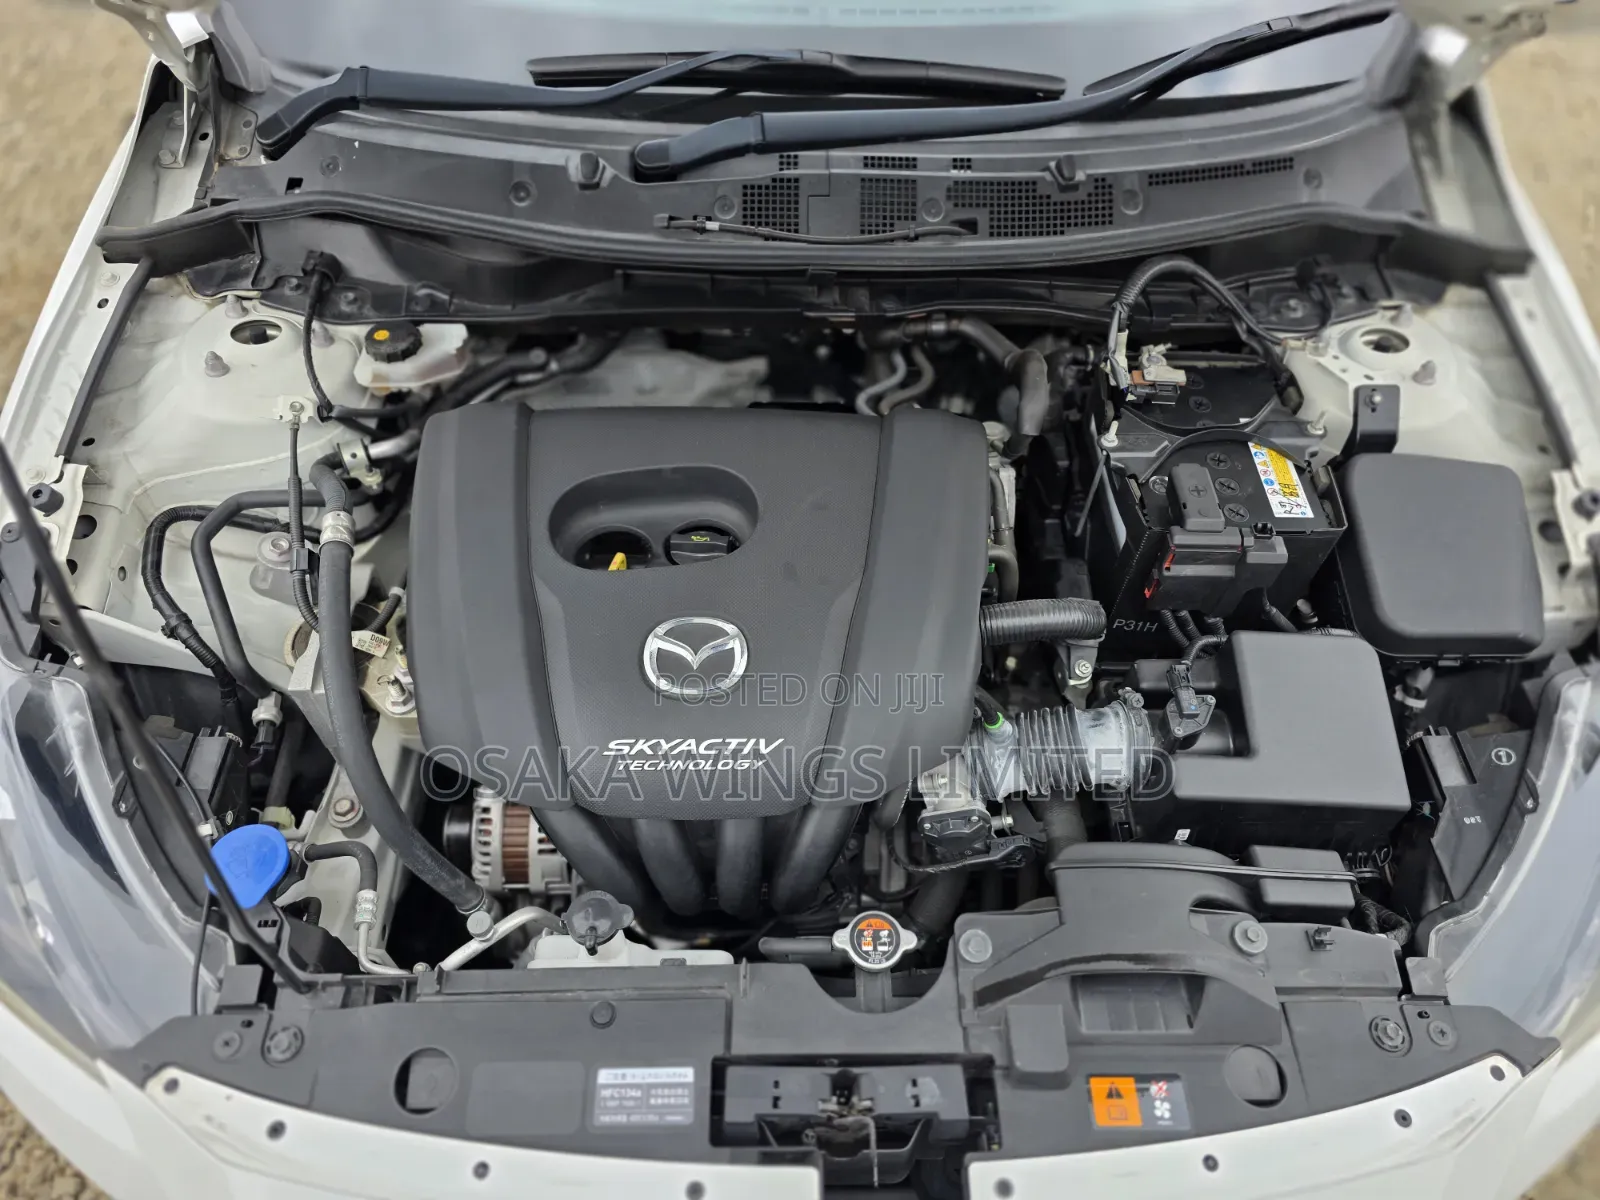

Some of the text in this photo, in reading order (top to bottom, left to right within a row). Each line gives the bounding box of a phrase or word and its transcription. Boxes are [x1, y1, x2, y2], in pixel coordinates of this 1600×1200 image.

[1112, 618, 1159, 632] P31H
[602, 738, 785, 756] SKYACTIV
[617, 759, 768, 771] TECHNOLOGY
